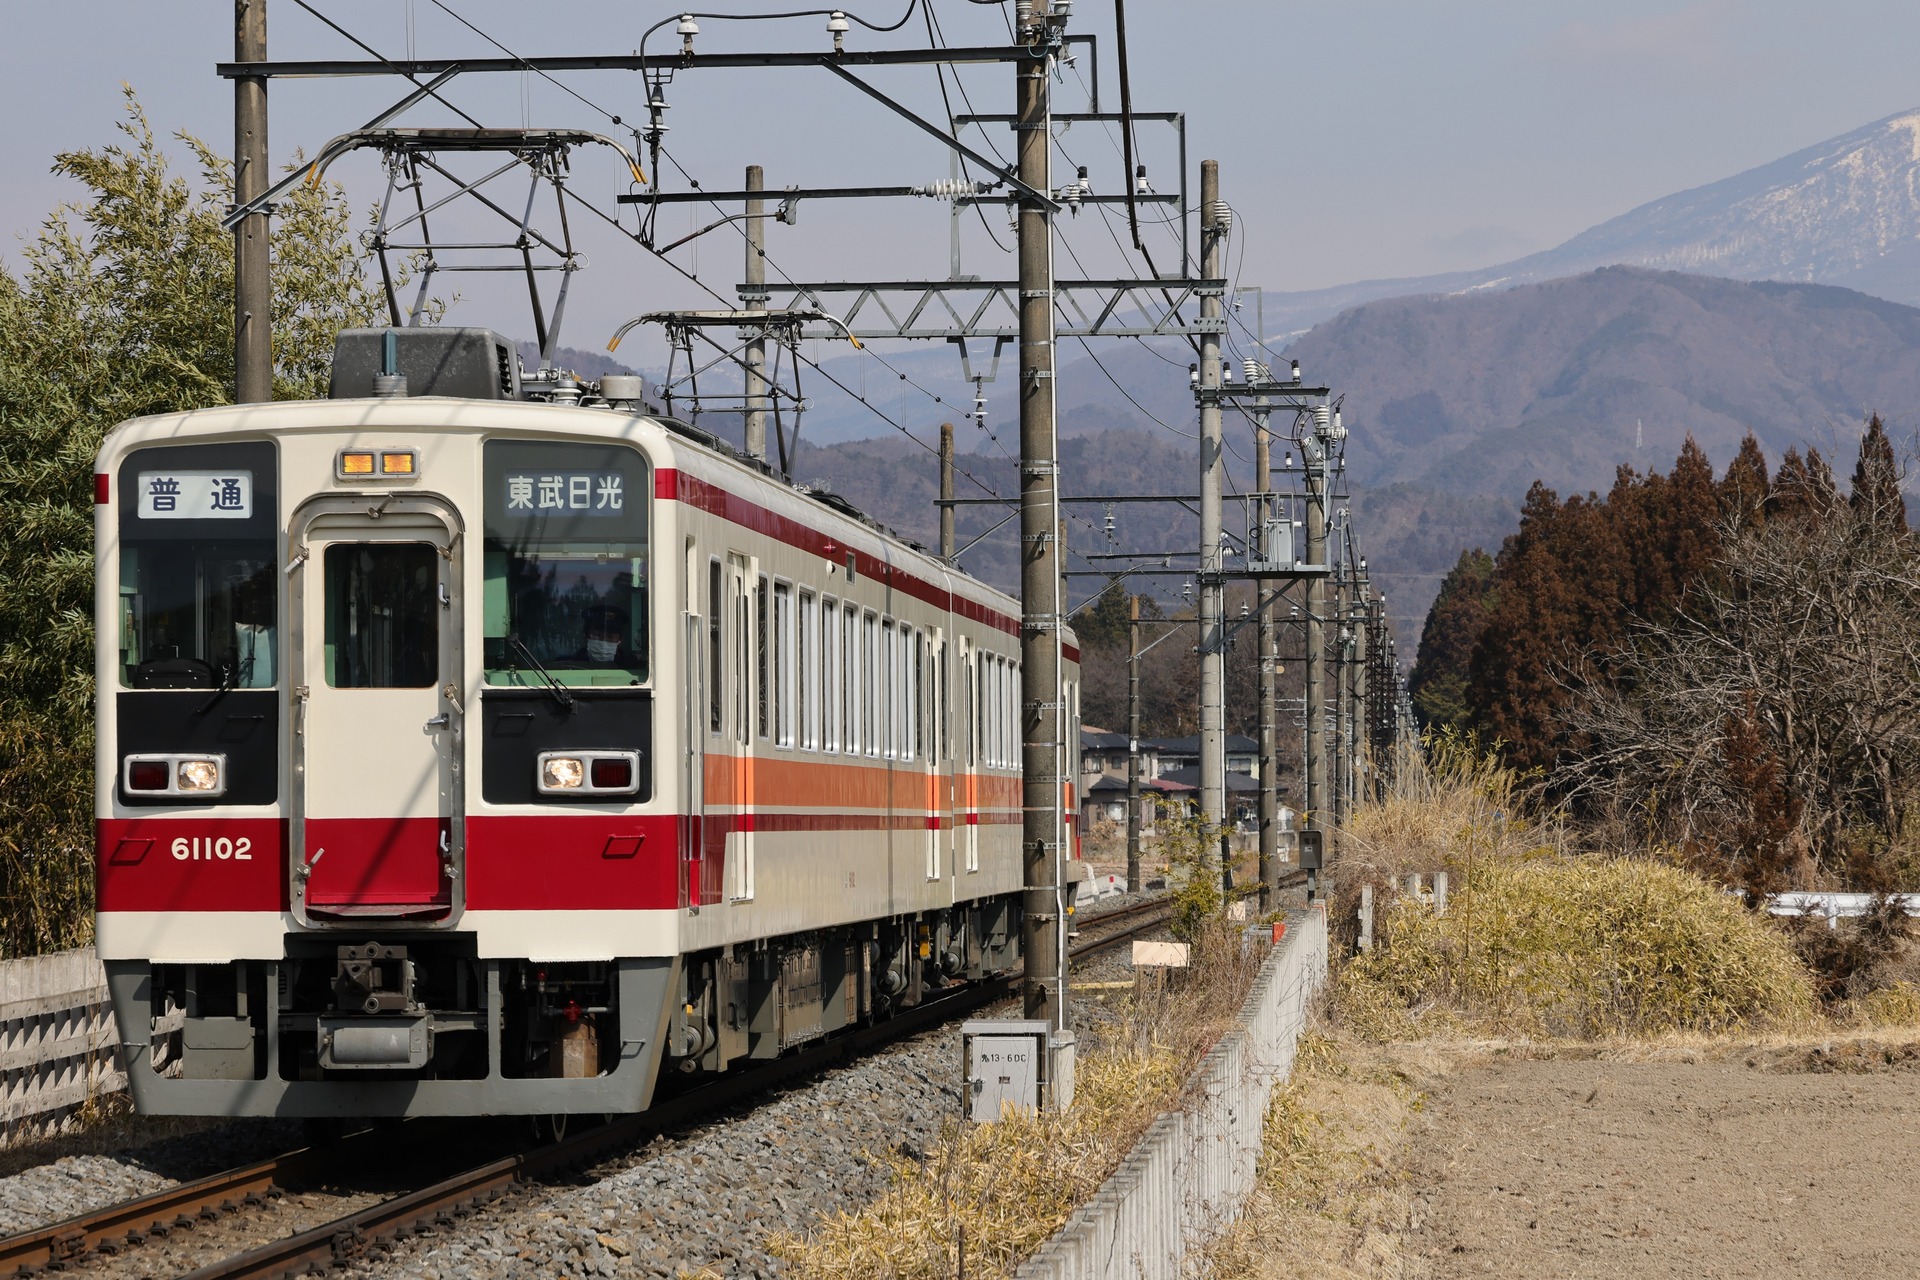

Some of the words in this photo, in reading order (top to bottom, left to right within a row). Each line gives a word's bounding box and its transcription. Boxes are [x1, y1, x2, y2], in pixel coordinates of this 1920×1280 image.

[148, 477, 244, 512] 普通
[508, 475, 623, 510] 東武日光
[171, 837, 252, 860] 61102
